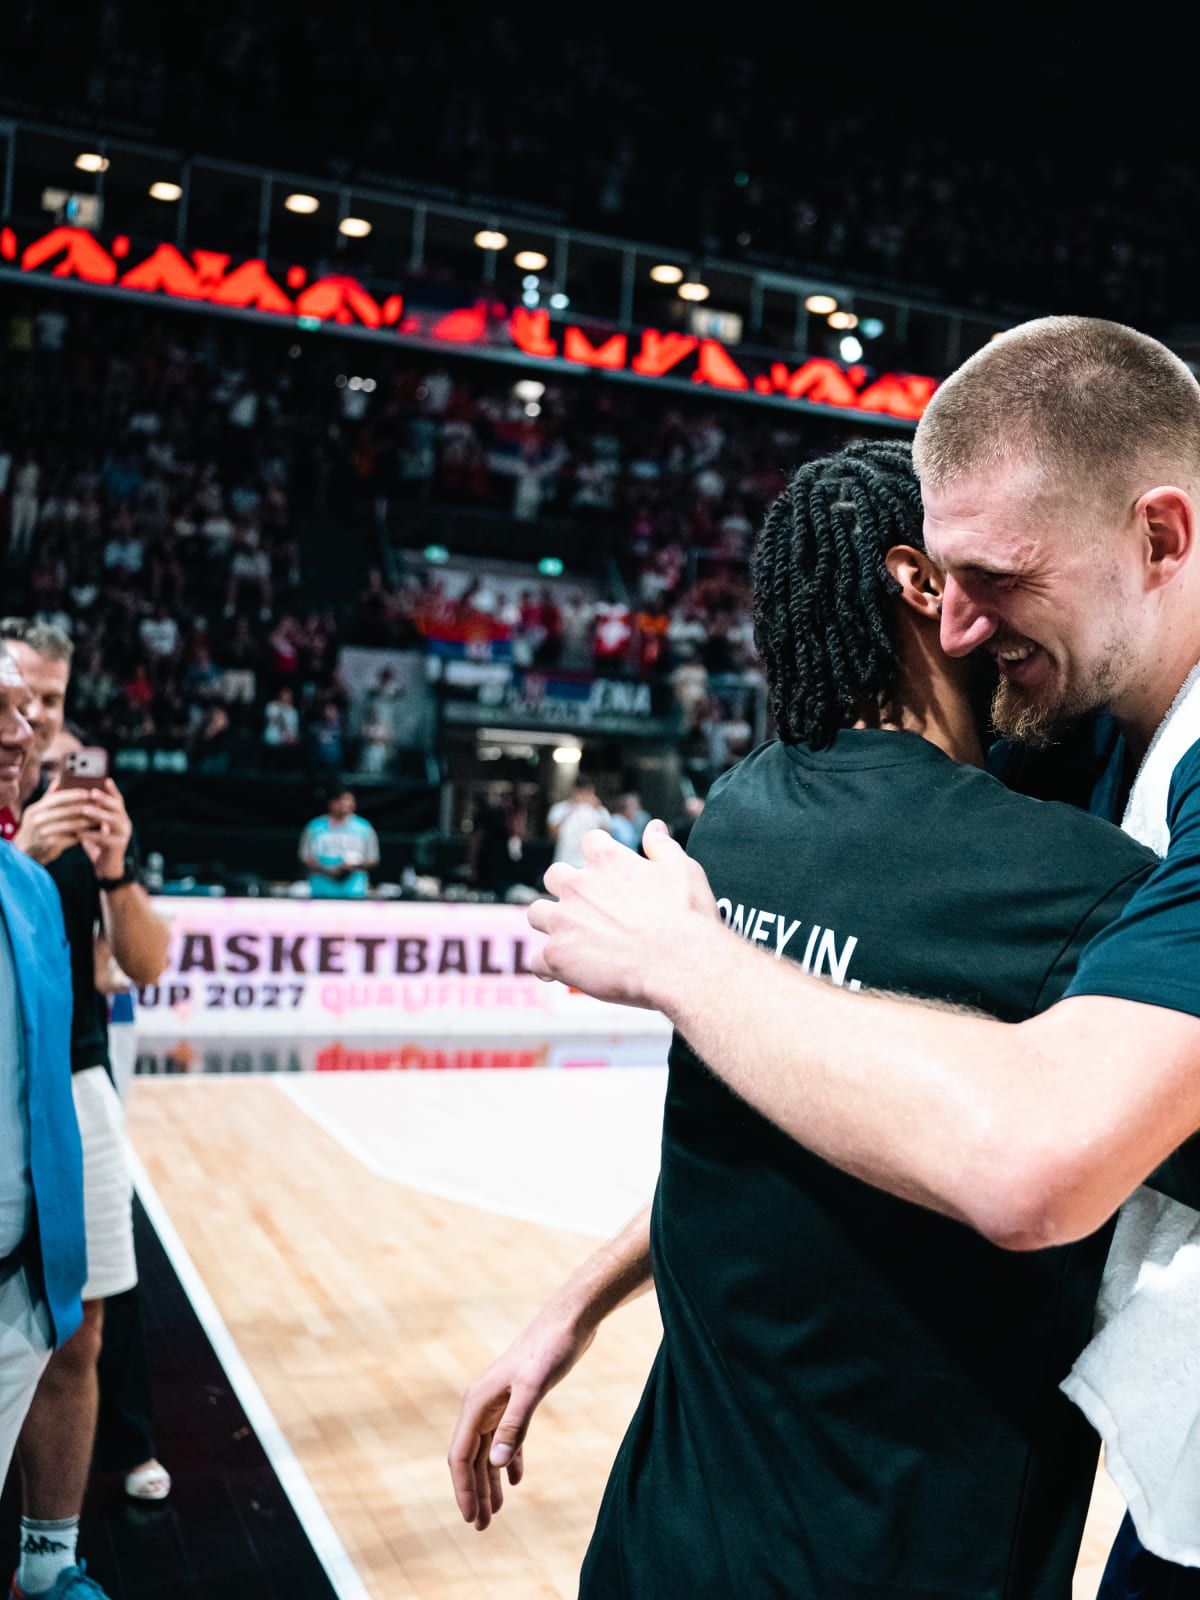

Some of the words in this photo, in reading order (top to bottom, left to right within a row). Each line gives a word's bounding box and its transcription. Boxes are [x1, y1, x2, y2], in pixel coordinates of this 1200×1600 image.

[178, 933, 535, 975] ASKETBALL
[716, 897, 801, 960] ONEY
[802, 925, 862, 992] IN.
[138, 984, 190, 1008] UP
[206, 984, 304, 1008] 2027
